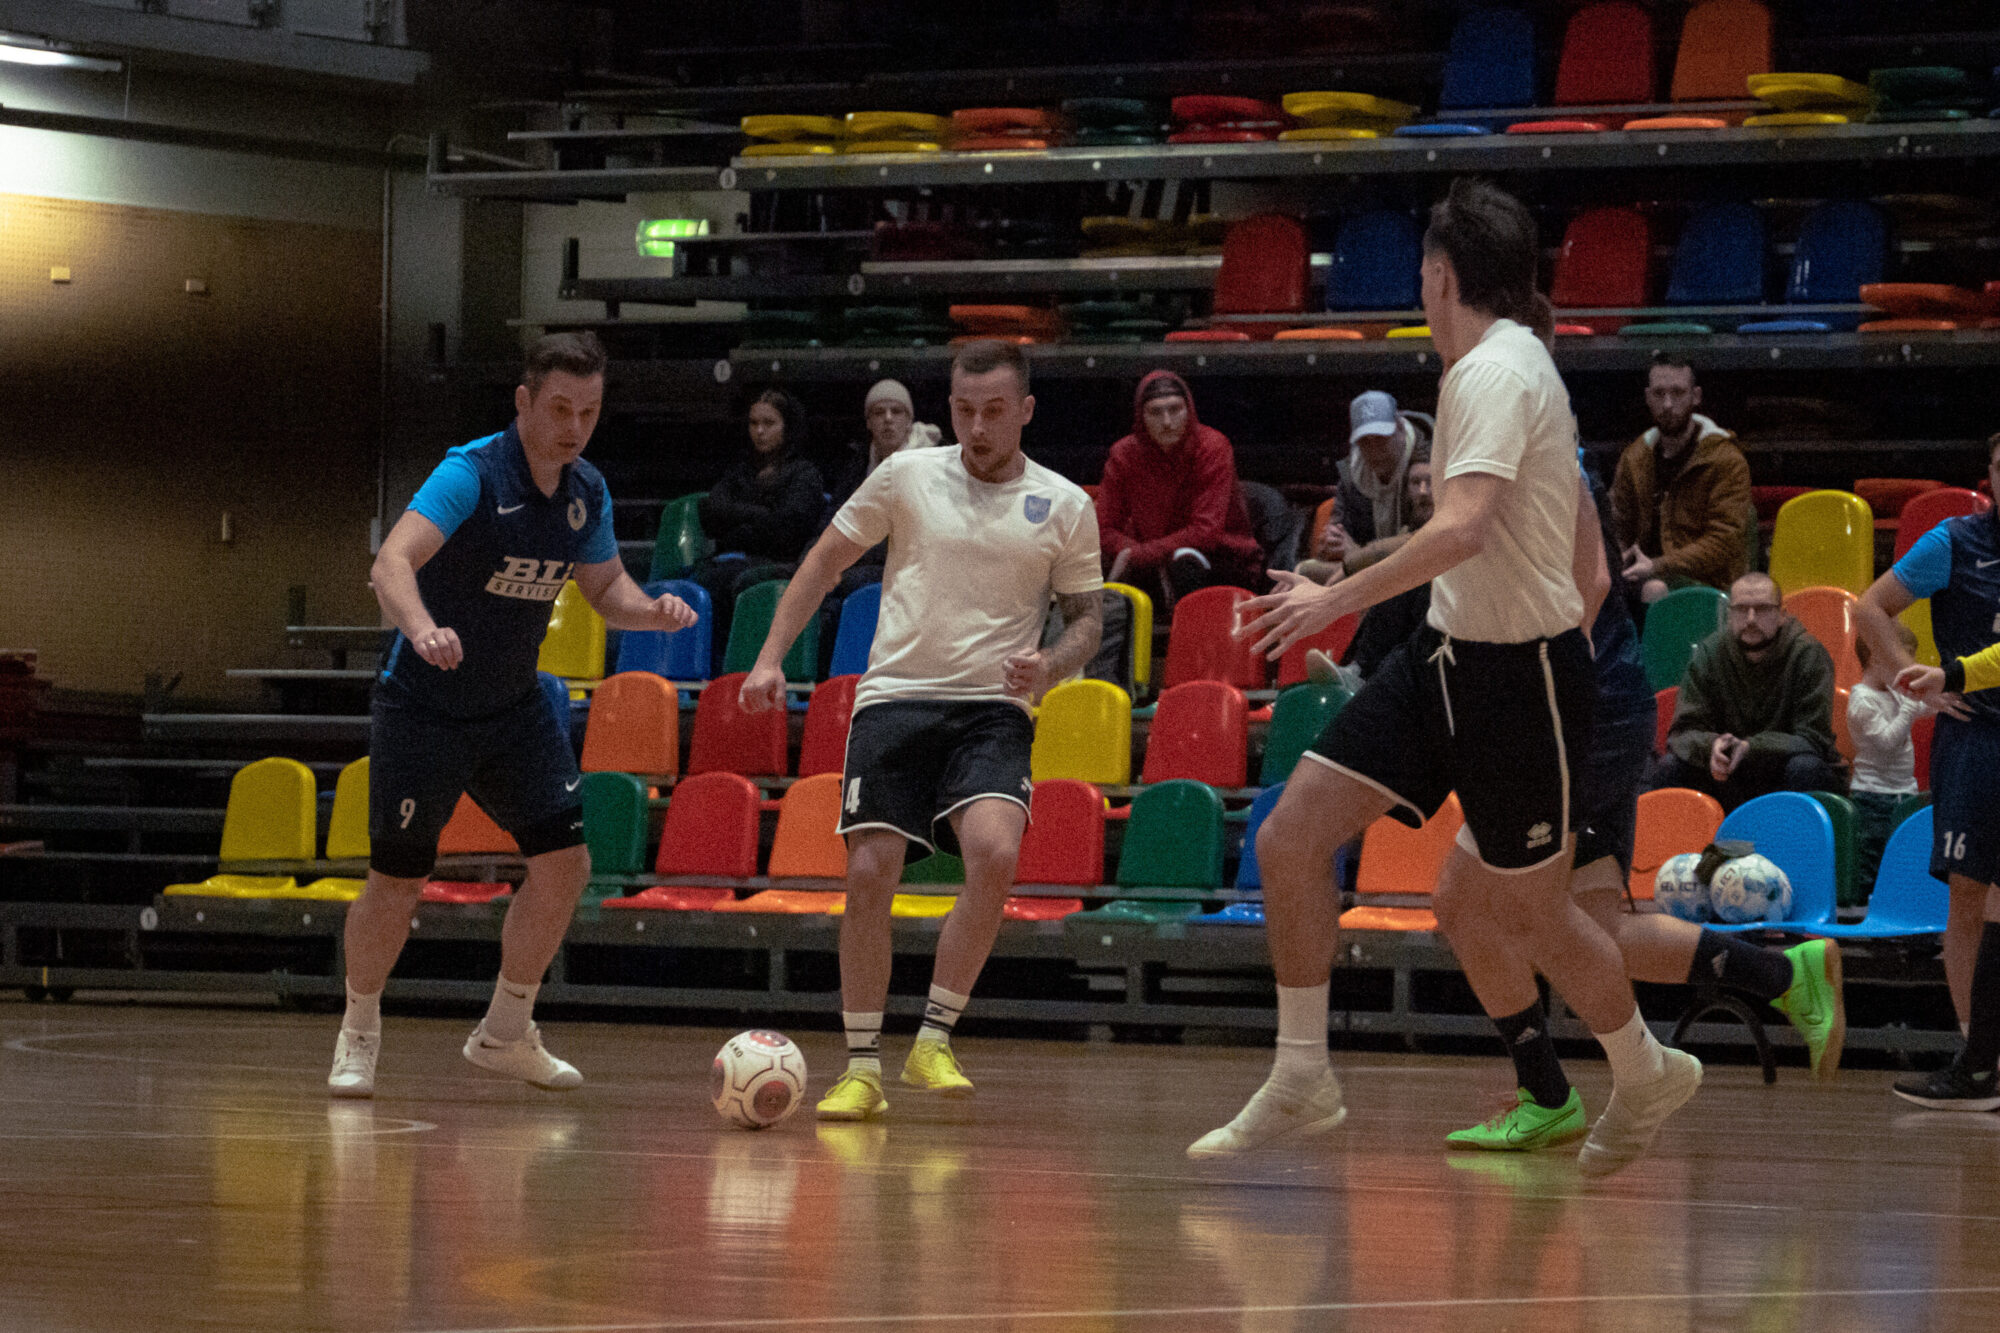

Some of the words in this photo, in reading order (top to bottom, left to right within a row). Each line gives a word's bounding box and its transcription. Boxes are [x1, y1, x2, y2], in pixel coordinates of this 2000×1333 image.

[494, 556, 574, 585] BL
[400, 798, 416, 829] 9
[1943, 830, 1967, 860] 16
